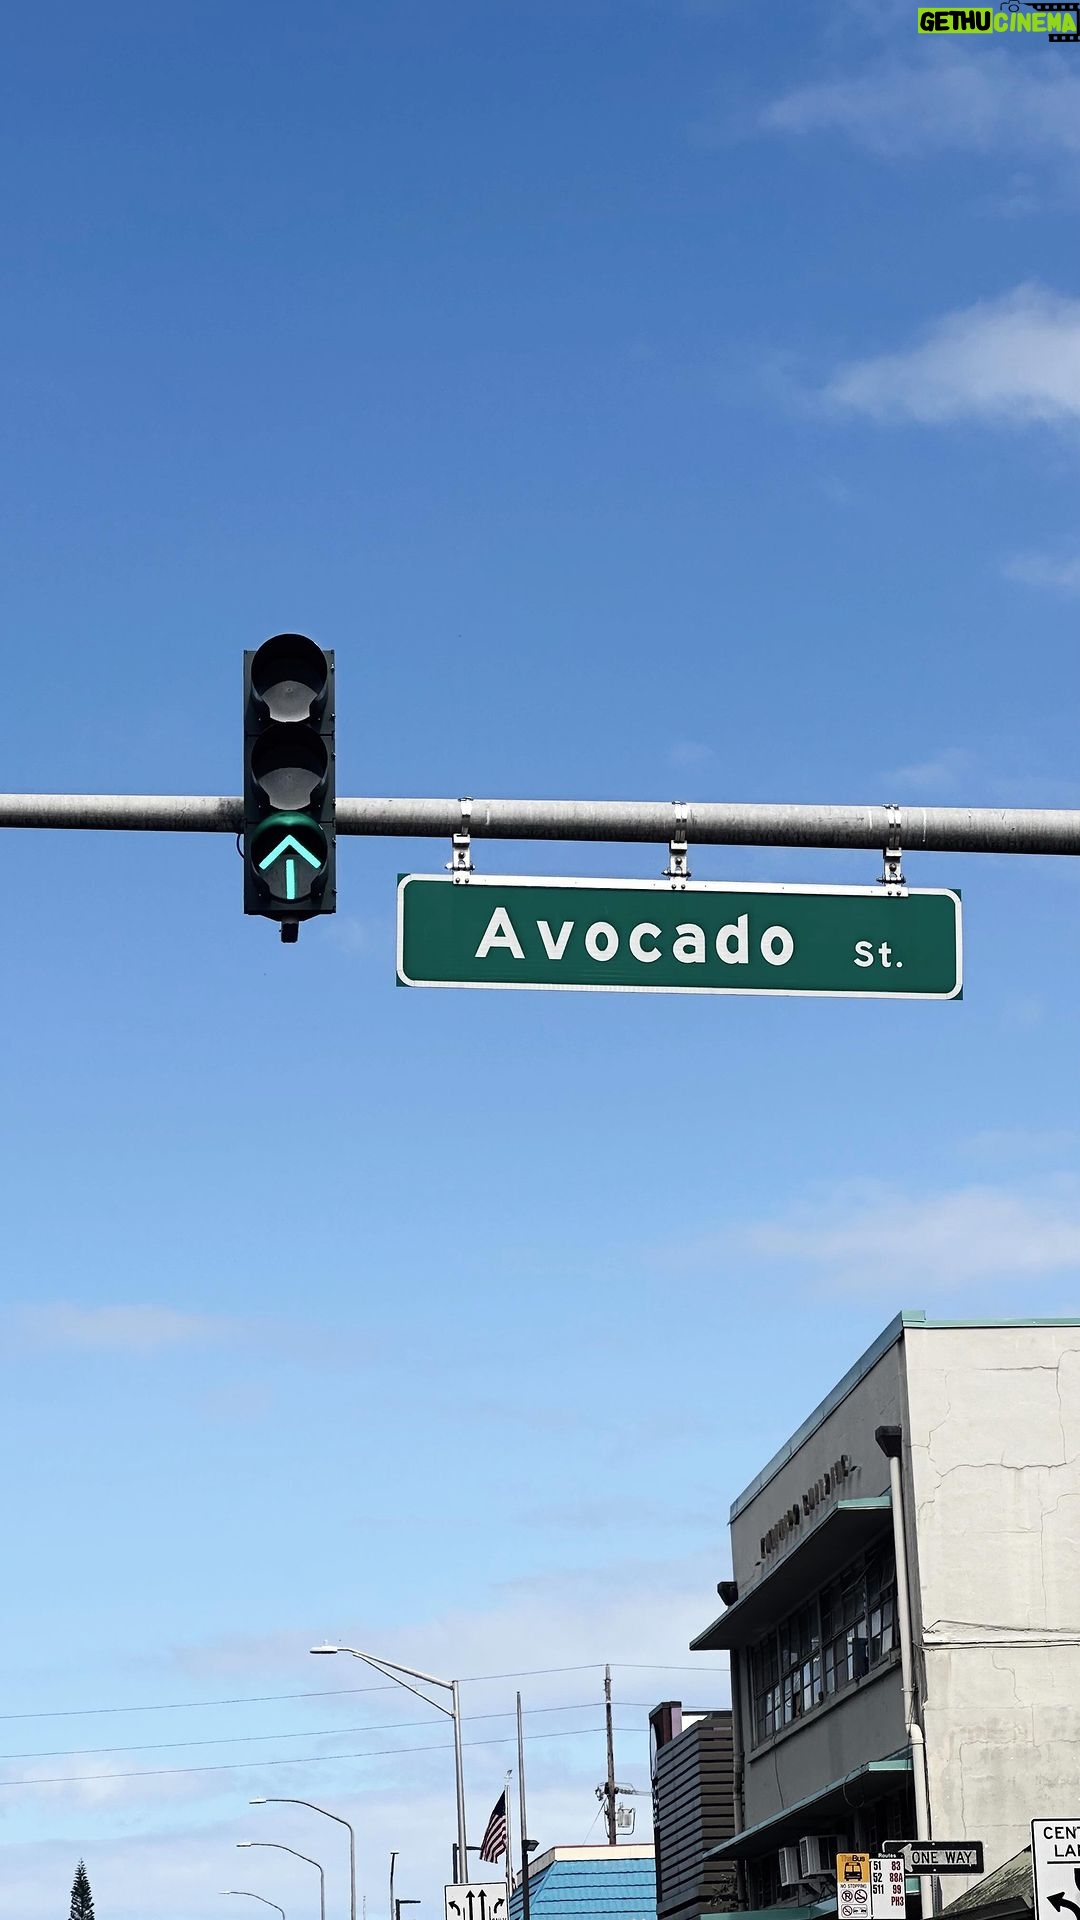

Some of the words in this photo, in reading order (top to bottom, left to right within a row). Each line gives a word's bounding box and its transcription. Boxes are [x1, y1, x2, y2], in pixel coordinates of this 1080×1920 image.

[474, 906, 795, 967] Avocado
[853, 940, 904, 969] St.
[1043, 1826, 1080, 1840] CEN
[1054, 1844, 1080, 1857] LA
[912, 1851, 939, 1864] ONE
[945, 1850, 972, 1864] WAY
[873, 1861, 882, 1871] 51
[891, 1861, 901, 1871] 83
[872, 1872, 883, 1883] 52
[872, 1884, 884, 1895] 511
[891, 1896, 904, 1907] PH3
